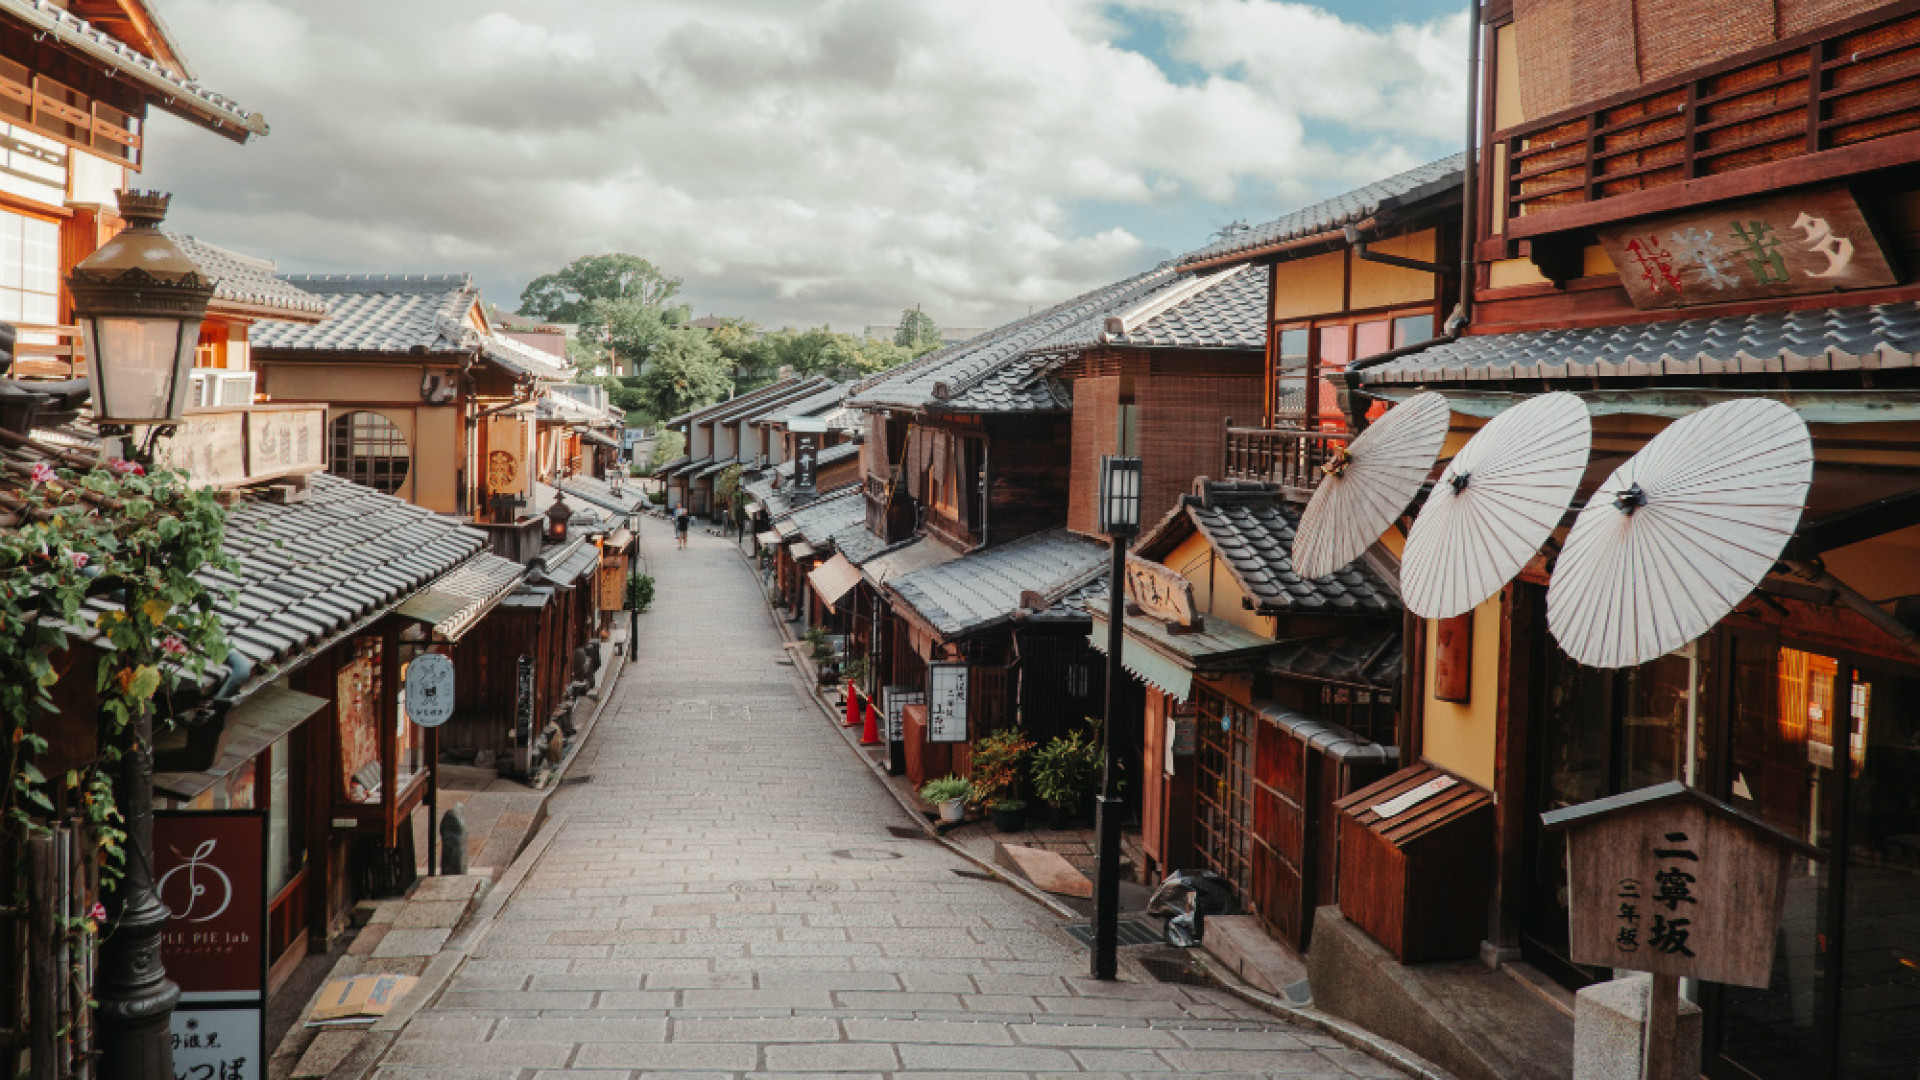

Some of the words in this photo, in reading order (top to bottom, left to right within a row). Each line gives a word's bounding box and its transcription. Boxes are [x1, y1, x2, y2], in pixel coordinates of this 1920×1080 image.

[1647, 831, 1700, 958] 二寧坂
[193, 931, 218, 944] PIE
[226, 931, 249, 943] lab
